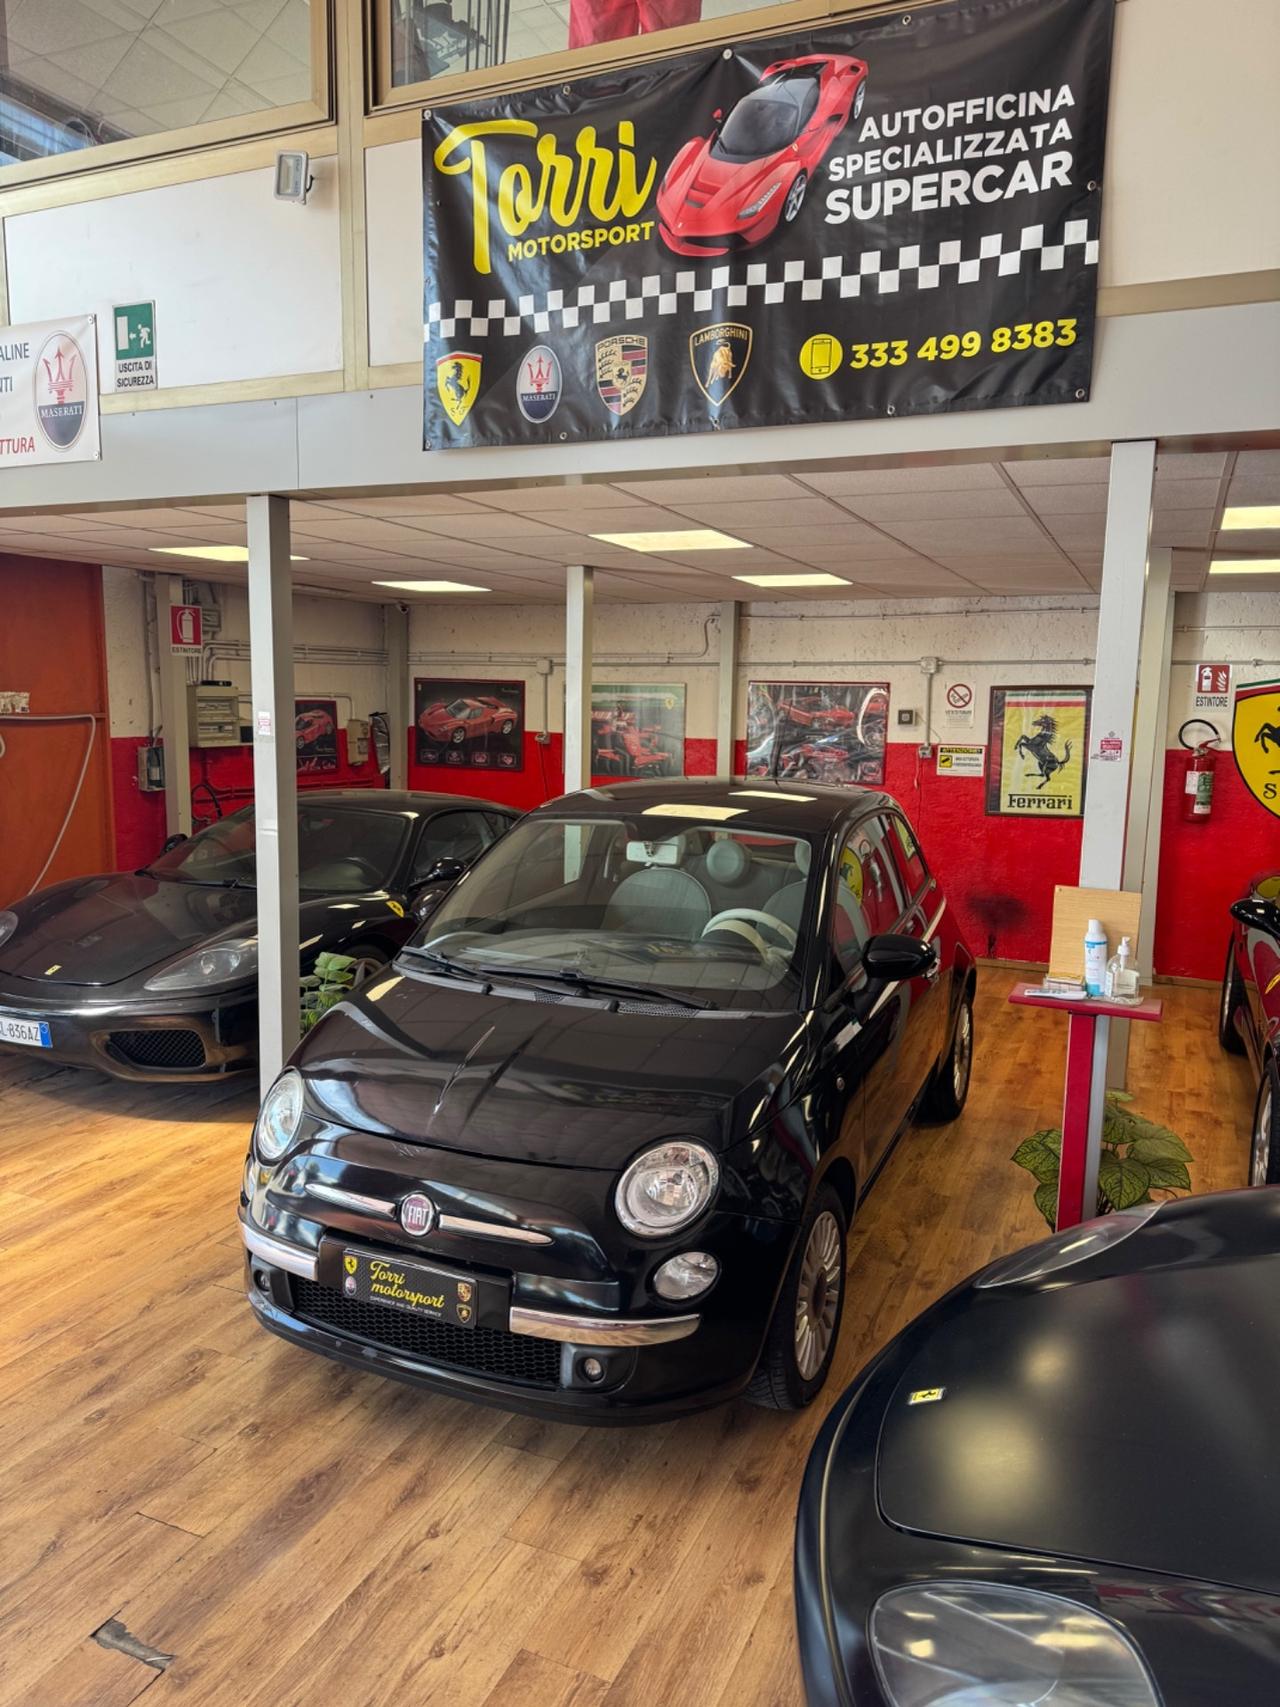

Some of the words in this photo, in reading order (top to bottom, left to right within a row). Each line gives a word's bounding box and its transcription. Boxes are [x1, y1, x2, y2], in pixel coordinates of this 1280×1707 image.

[858, 84, 1076, 143] AUTOFFICINA
[828, 117, 1073, 182] SPECIALIZZATA
[434, 118, 658, 275] Torri
[824, 150, 1074, 225] SUPERCAR
[508, 220, 656, 263] MOTORSPORT
[598, 336, 646, 350] PORSCHE
[694, 327, 749, 347] LAMBORGHINI
[849, 339, 909, 369] 333
[917, 330, 982, 361] 499
[990, 318, 1078, 353] 8383
[119, 363, 143, 373] USCITA
[144, 360, 153, 372] DI
[117, 374, 154, 388] SICUREZZA
[521, 392, 556, 402] MASERATI
[40, 404, 83, 419] MASERATI
[1195, 696, 1229, 708] ESTINTORE
[1263, 782, 1277, 800] S
[1007, 793, 1073, 810] Ferrari
[408, 1206, 429, 1226] FIAT
[370, 1260, 406, 1286] Torri
[371, 1283, 445, 1308] motorsport
